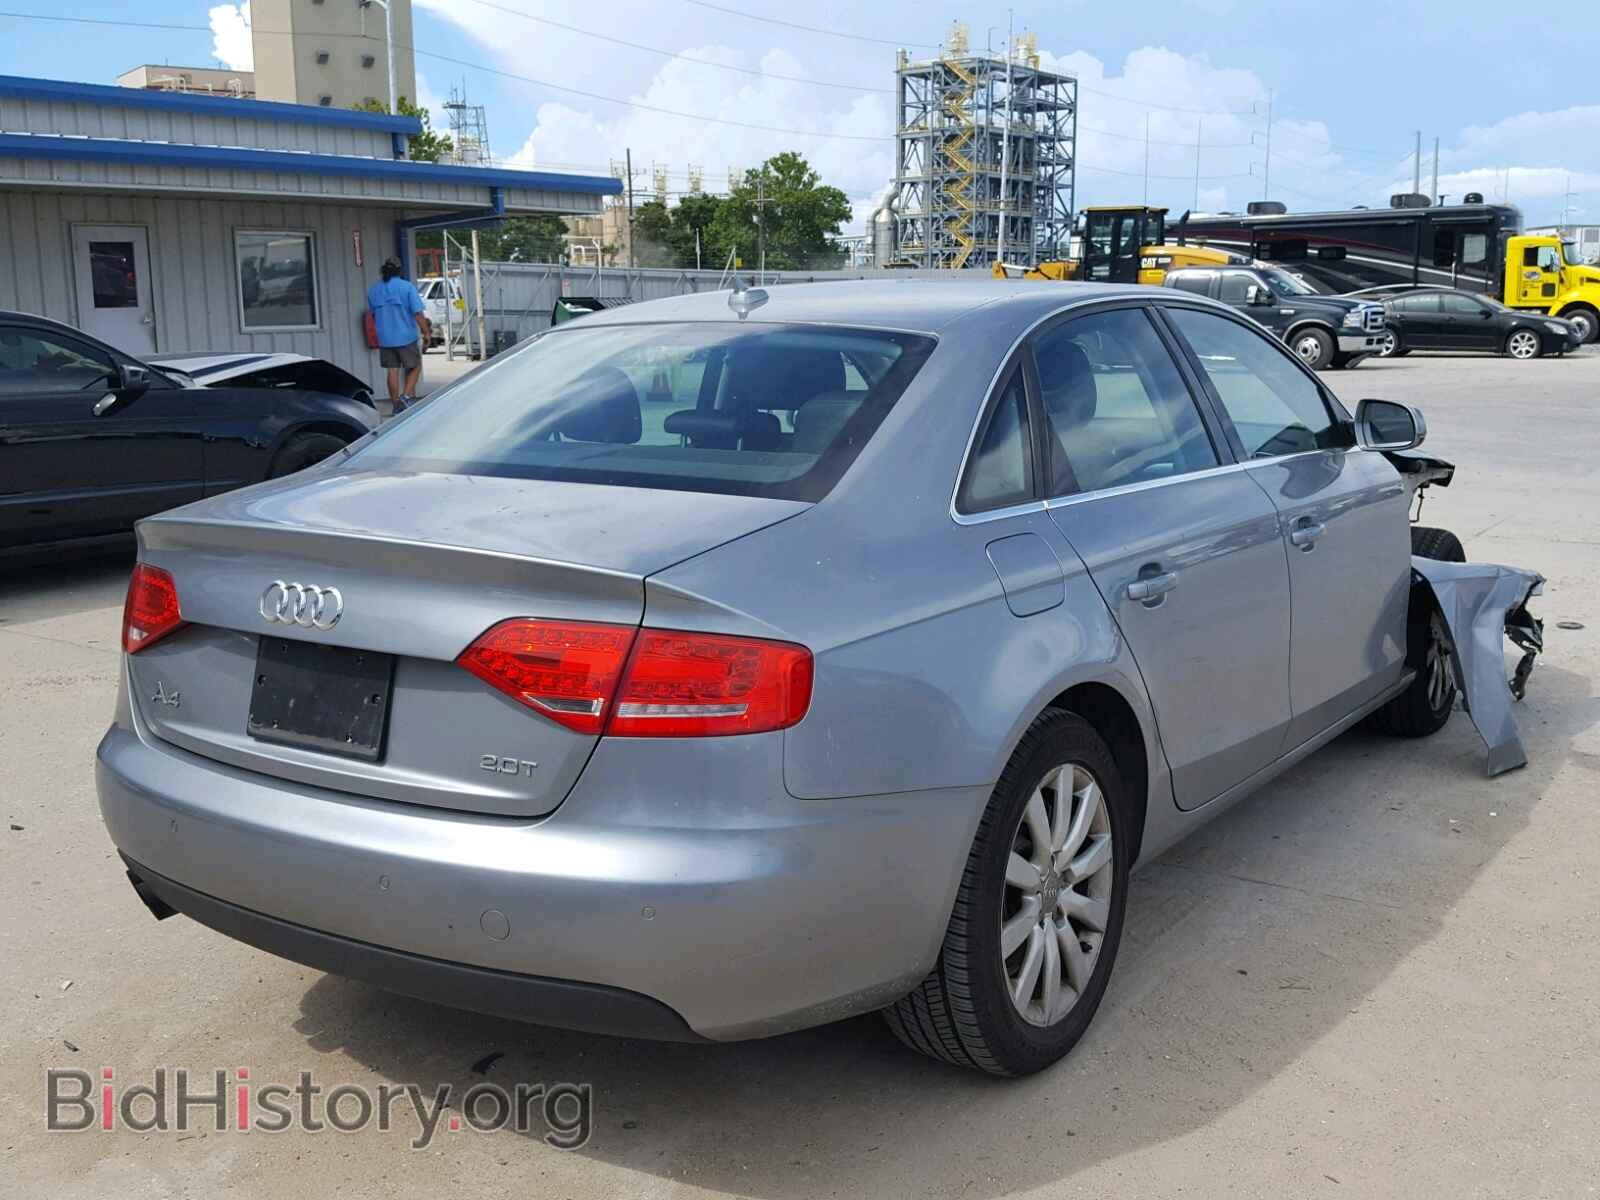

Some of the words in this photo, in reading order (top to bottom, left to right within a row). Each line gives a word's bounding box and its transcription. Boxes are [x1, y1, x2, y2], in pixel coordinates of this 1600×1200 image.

[1141, 257, 1157, 268] CAT
[151, 680, 180, 708] A4
[479, 754, 538, 776] 2.0T
